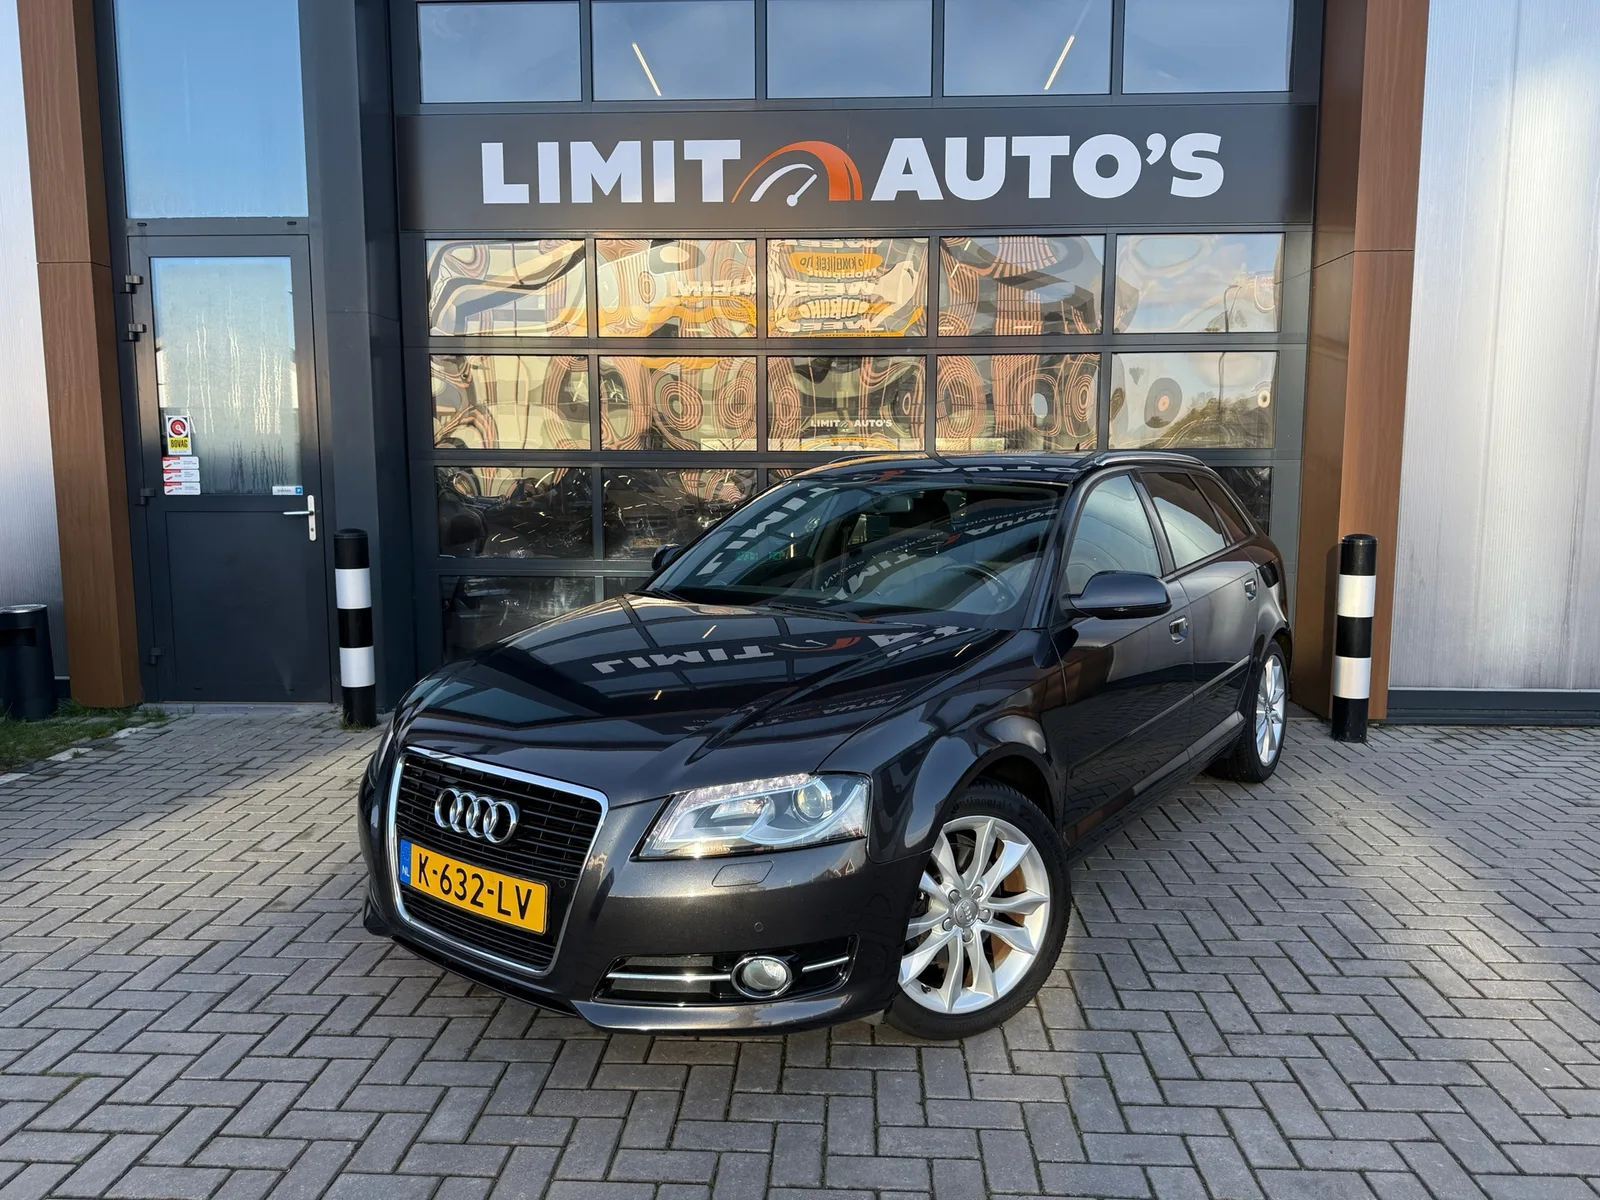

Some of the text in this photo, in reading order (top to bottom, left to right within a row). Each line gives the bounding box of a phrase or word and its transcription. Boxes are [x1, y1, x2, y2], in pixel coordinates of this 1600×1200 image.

[481, 132, 1225, 204] LIMIT AUTO'S
[810, 420, 892, 428] LIMIT AUTO'S
[170, 440, 188, 448] BOVAG
[401, 865, 410, 877] NL
[418, 853, 532, 920] K-632-LV
